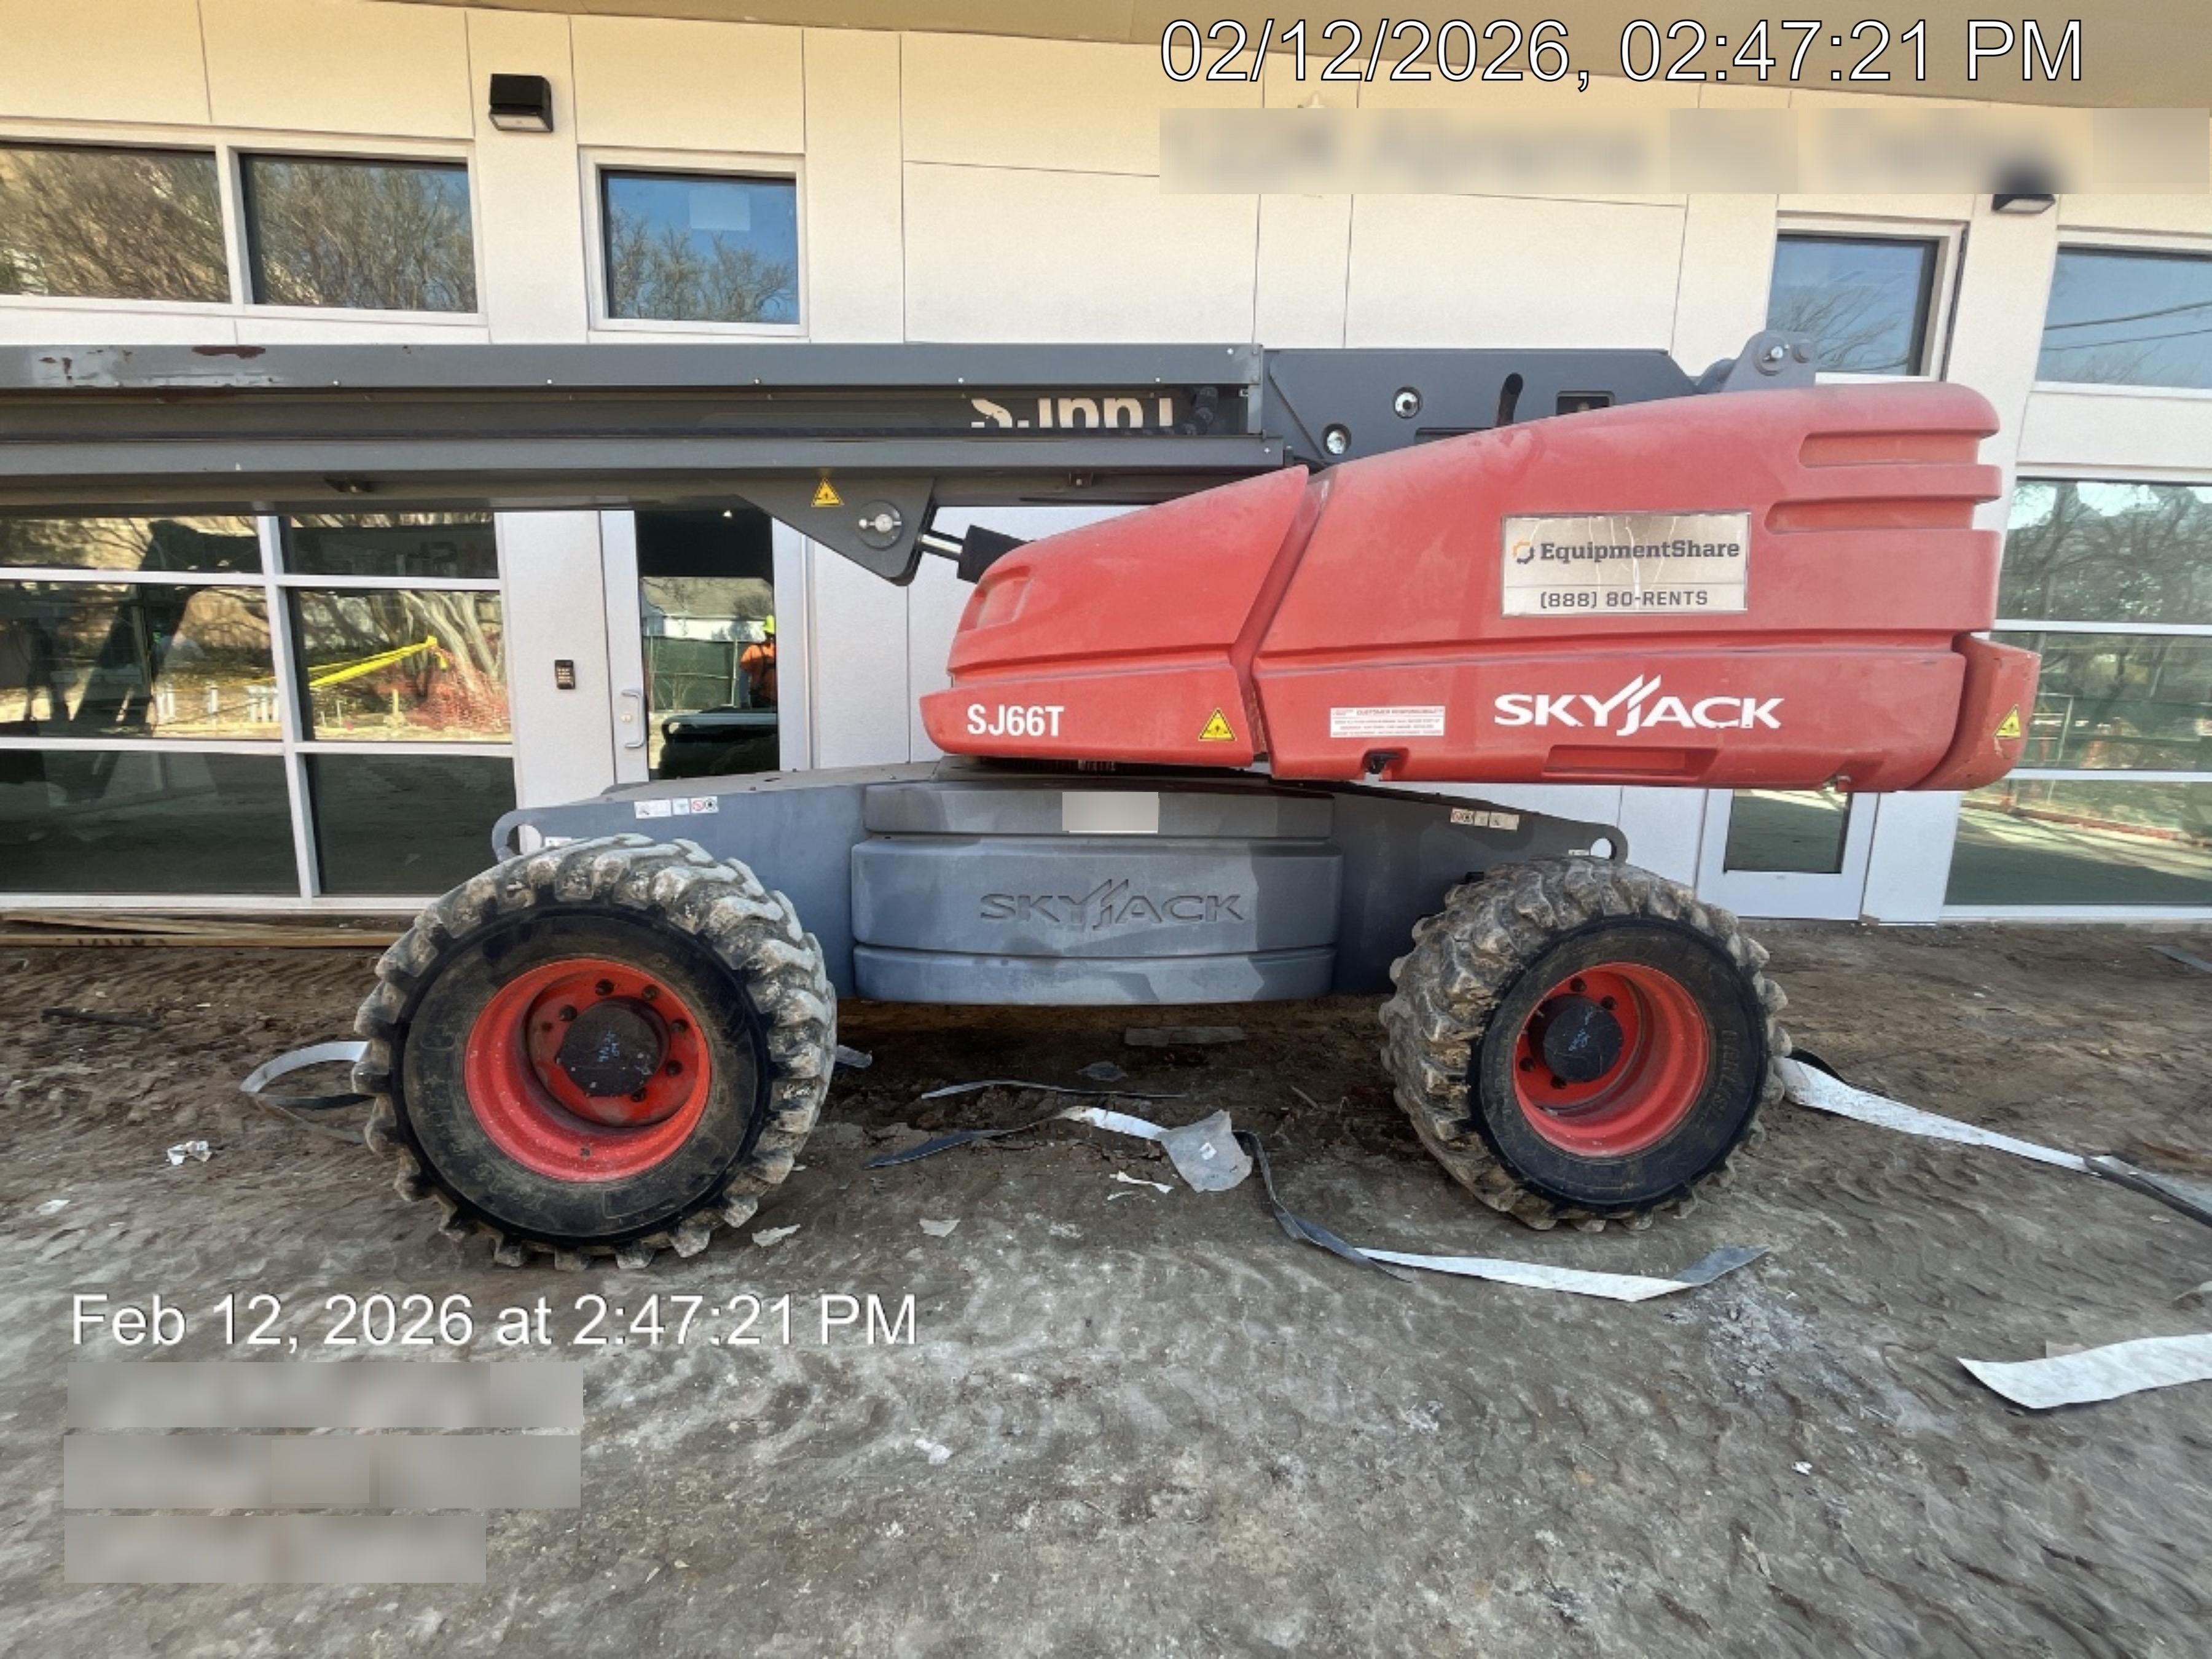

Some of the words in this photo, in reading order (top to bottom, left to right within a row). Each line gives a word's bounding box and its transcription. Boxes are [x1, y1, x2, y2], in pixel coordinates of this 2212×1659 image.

[1540, 539, 1740, 564] EquipmentShare
[1540, 591, 1598, 608] (888)
[1606, 590, 1708, 606] 80-RENTS
[967, 704, 1065, 737] SJ66T
[1494, 674, 1785, 736] SKYJACK
[980, 878, 1244, 932] SKYJACK
